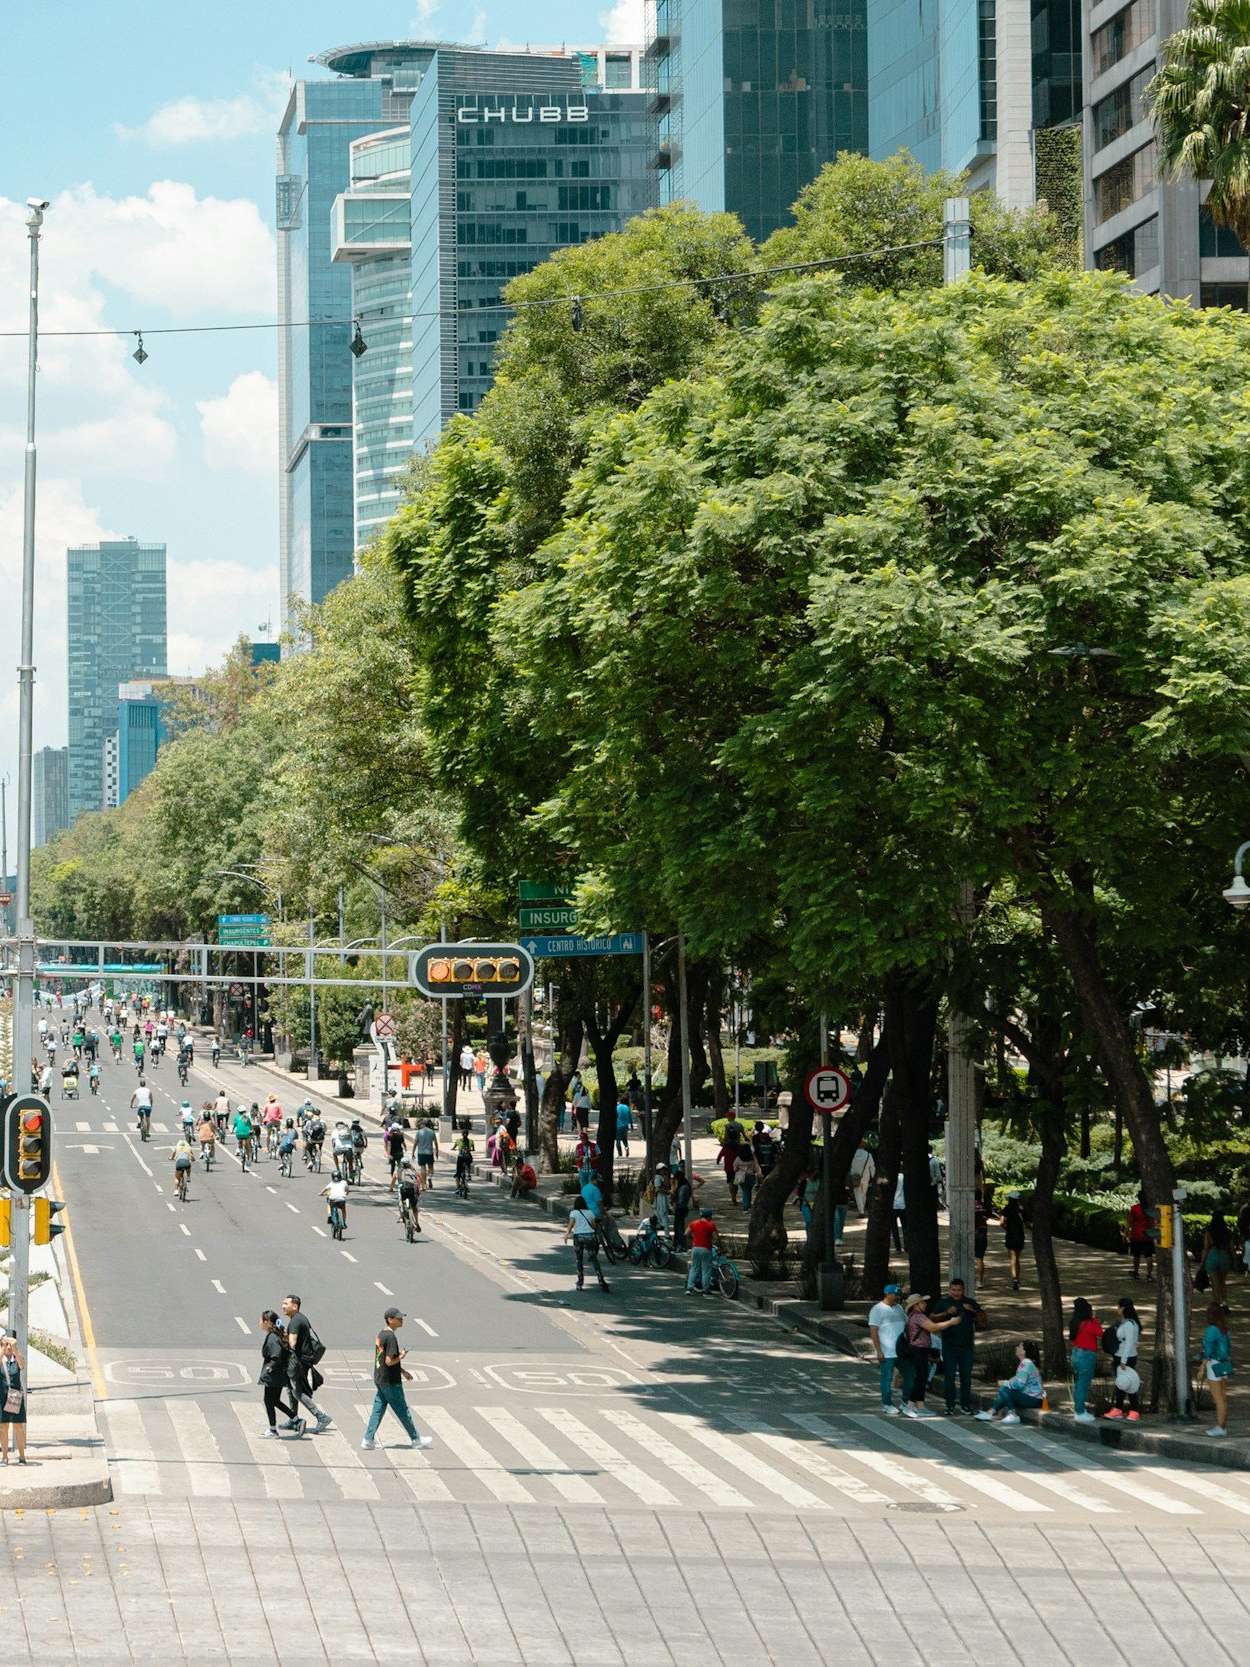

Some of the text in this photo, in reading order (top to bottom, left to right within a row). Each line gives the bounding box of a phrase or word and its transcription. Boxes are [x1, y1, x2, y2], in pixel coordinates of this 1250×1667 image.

[458, 106, 589, 122] CHUBB
[530, 911, 579, 924] INSURG
[547, 940, 574, 952] CENTRO
[127, 1366, 230, 1379] 50
[512, 1371, 622, 1386] 50
